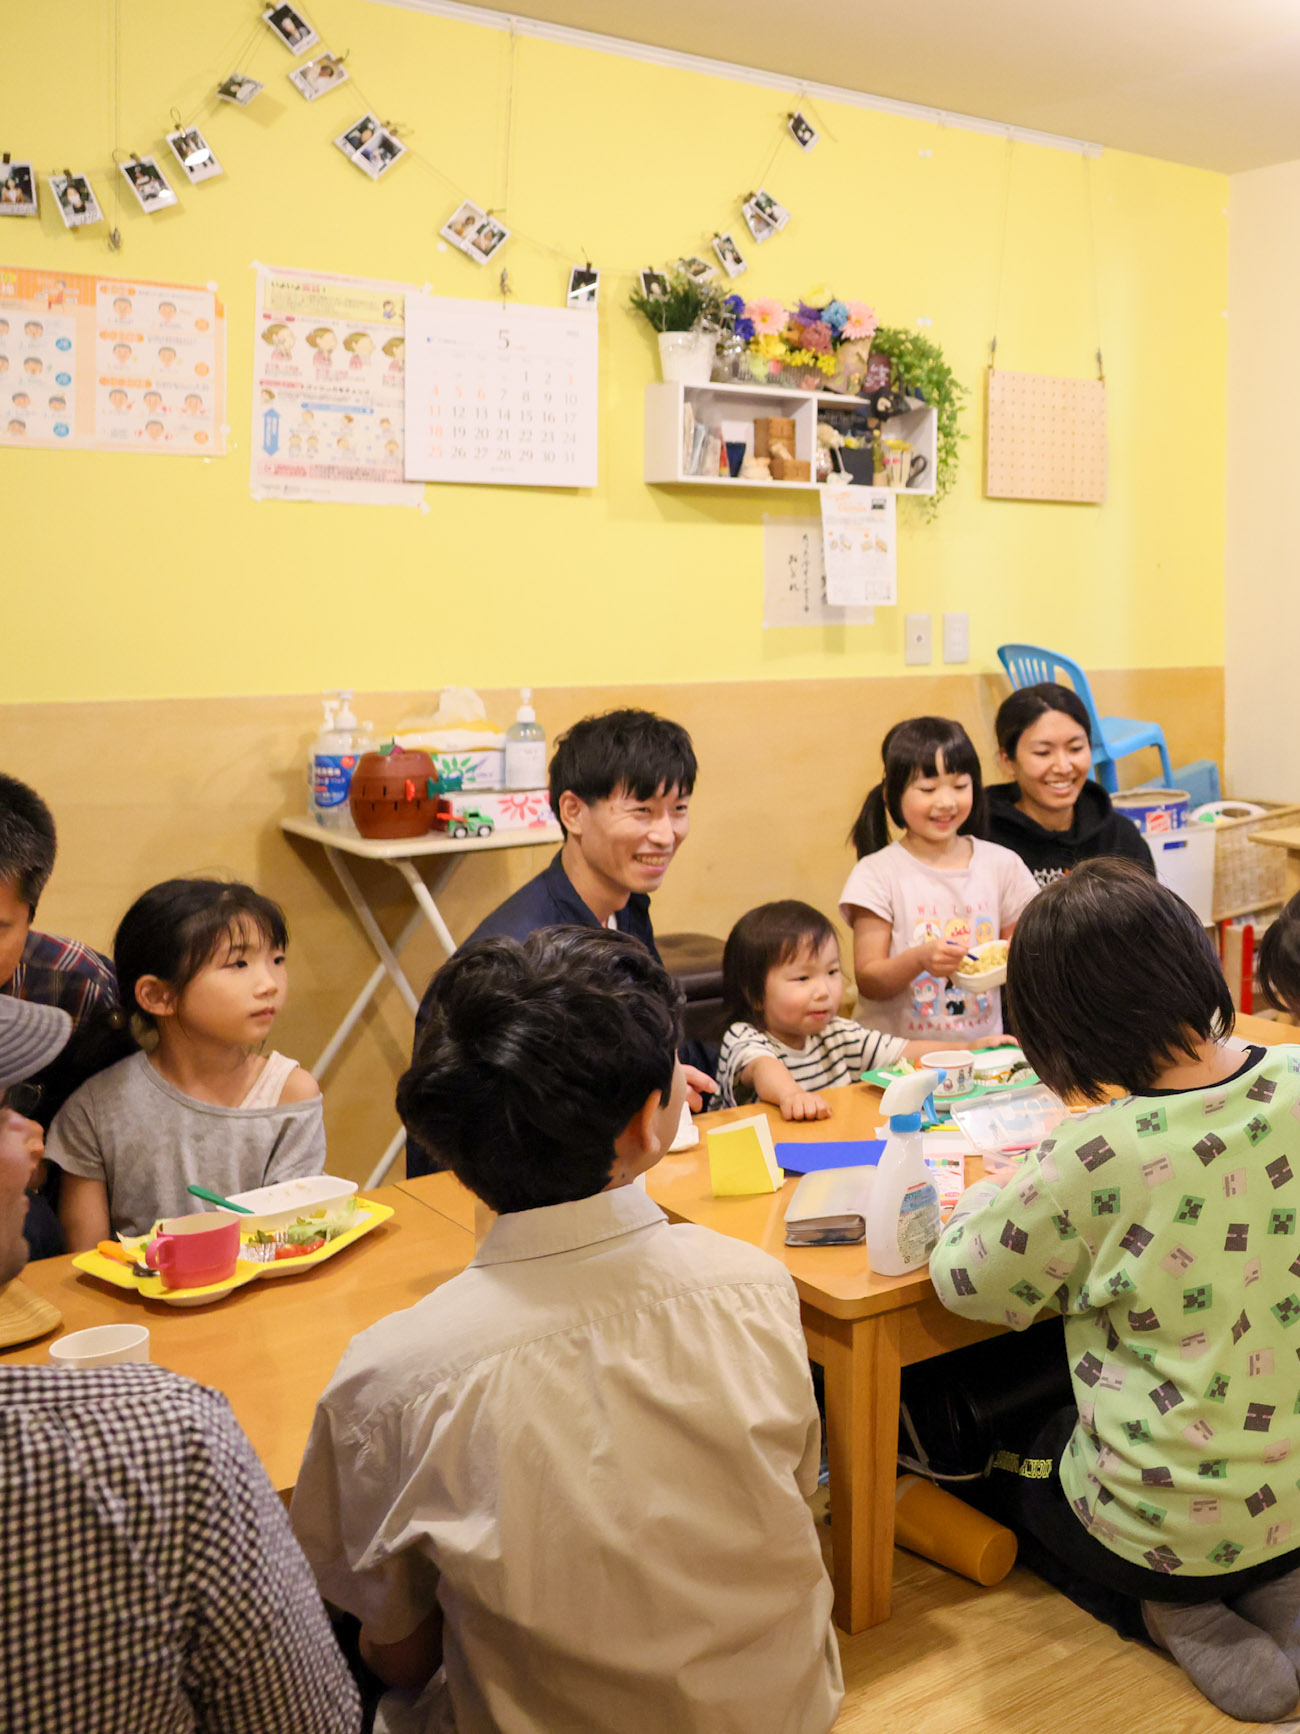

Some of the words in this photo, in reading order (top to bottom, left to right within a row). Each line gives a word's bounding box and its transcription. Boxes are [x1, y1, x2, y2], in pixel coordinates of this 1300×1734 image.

[498, 328, 510, 349] 5
[564, 392, 578, 406] 10
[429, 404, 441, 417] 11
[452, 406, 465, 419] 12
[476, 407, 488, 420] 13
[498, 408, 511, 421] 14
[520, 409, 533, 423] 15
[542, 411, 556, 424] 16
[564, 412, 577, 424] 17
[452, 425, 466, 439] 19
[474, 427, 489, 441] 20
[496, 427, 509, 441] 21
[519, 428, 533, 443] 22
[451, 445, 467, 459] 26
[474, 446, 488, 459] 27
[496, 447, 511, 461] 28
[519, 449, 534, 462] 29
